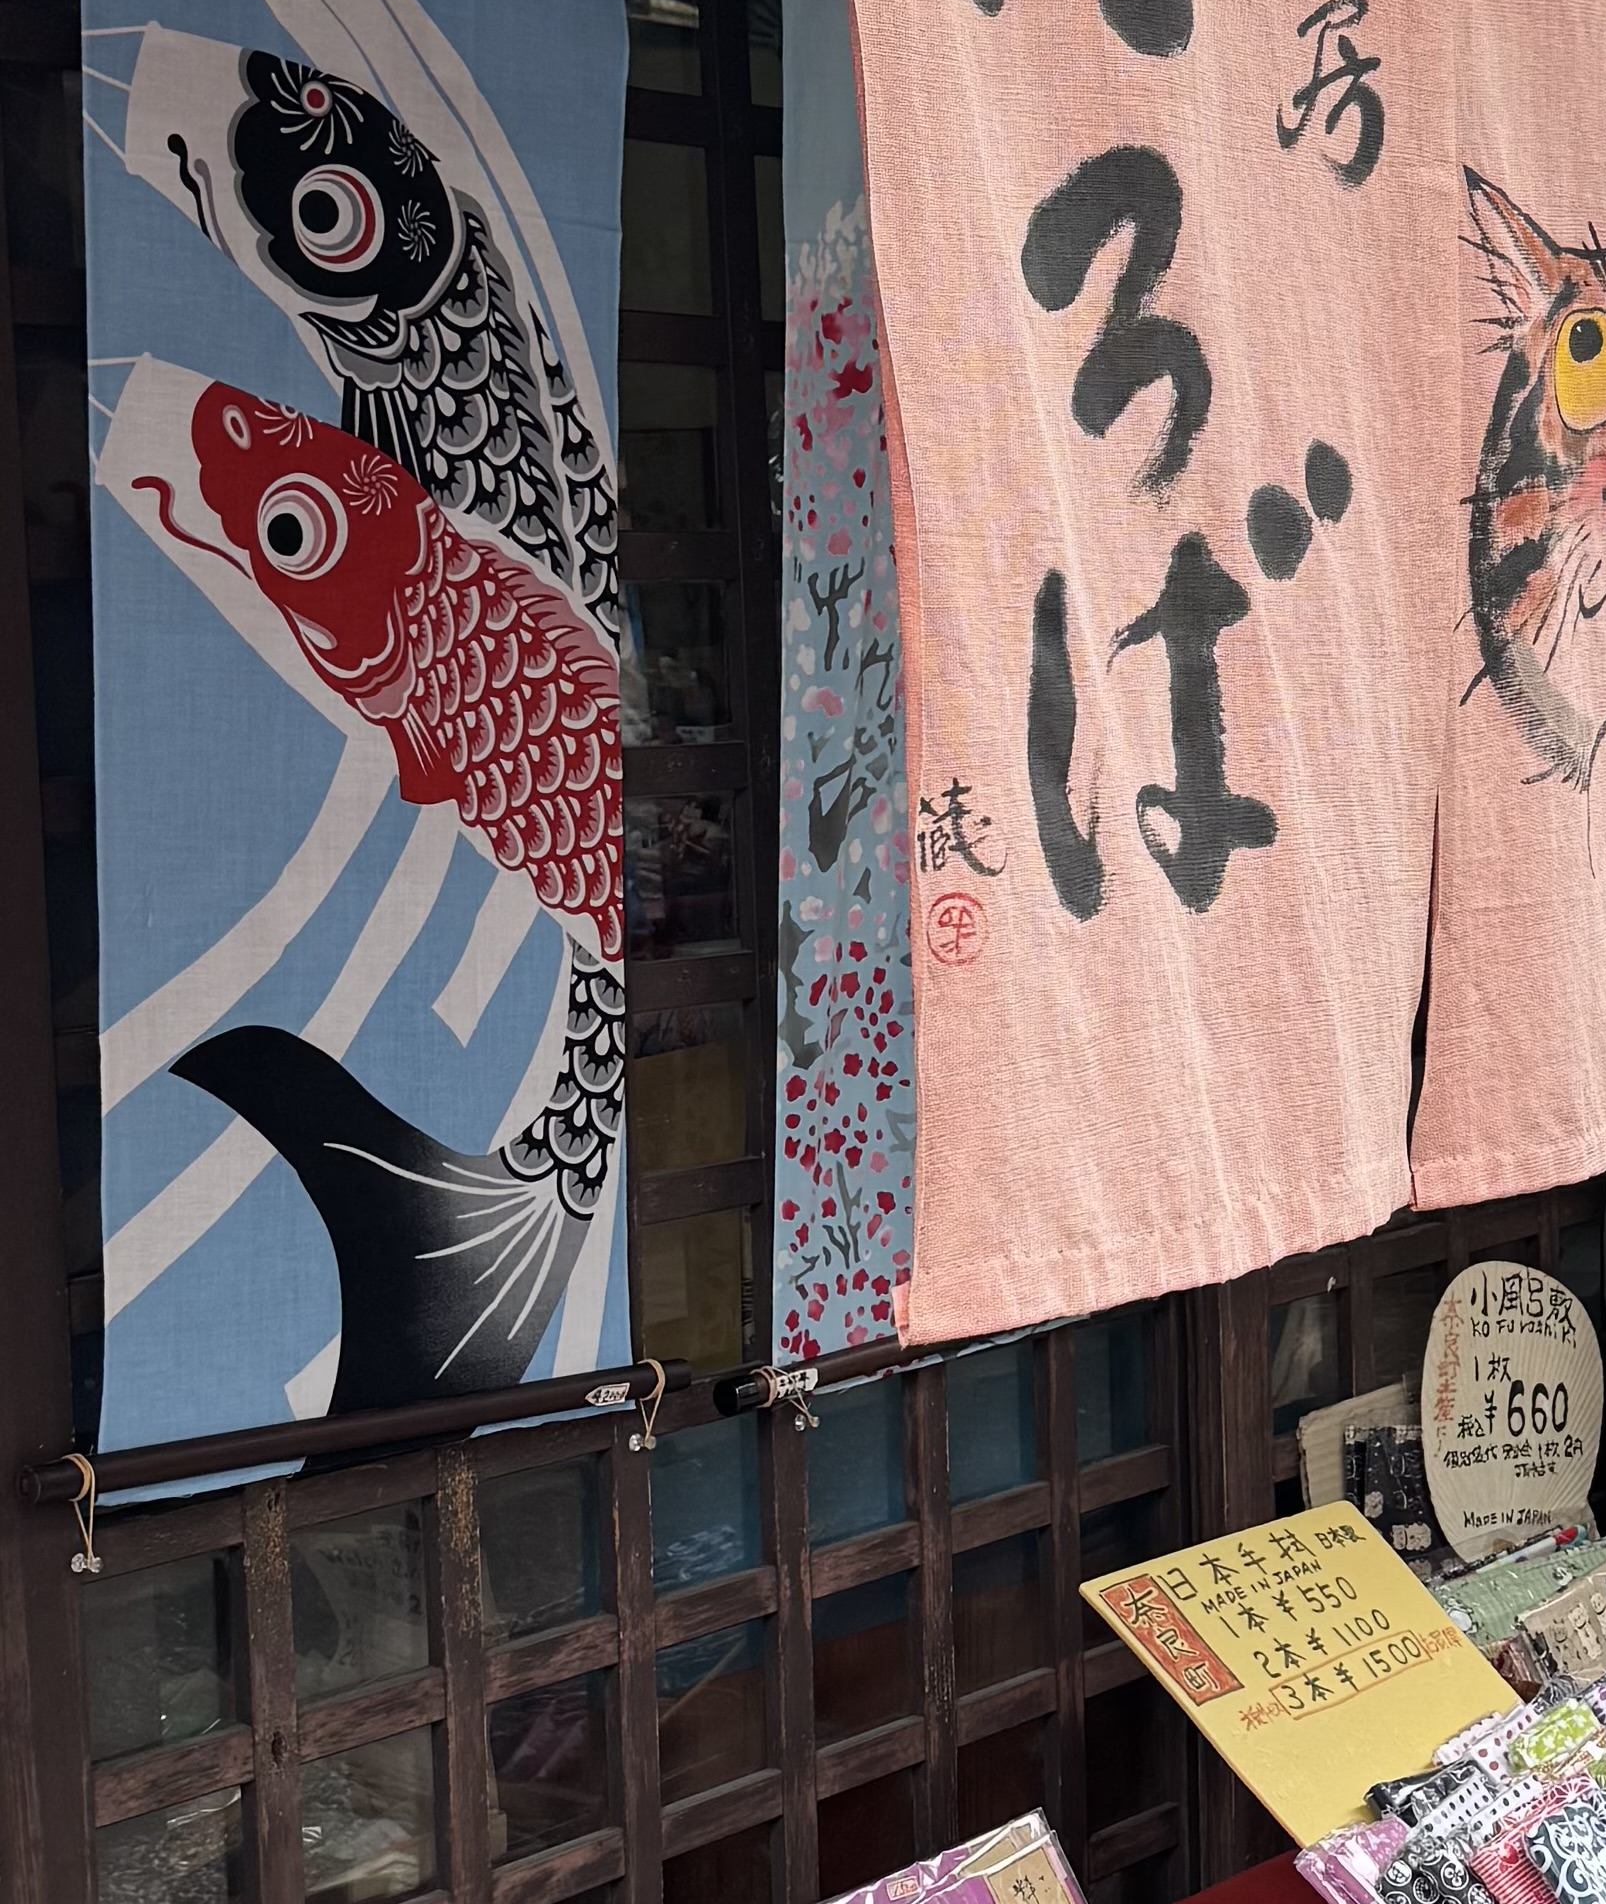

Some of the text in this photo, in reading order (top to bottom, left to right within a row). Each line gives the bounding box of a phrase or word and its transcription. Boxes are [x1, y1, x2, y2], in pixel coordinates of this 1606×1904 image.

[1470, 1267, 1574, 1326] 小風呂敷
[1517, 1507, 1552, 1526] JAPAN
[1201, 1559, 1323, 1615] MADE IN JAPAN
[1123, 1584, 1220, 1693] 奈良町
